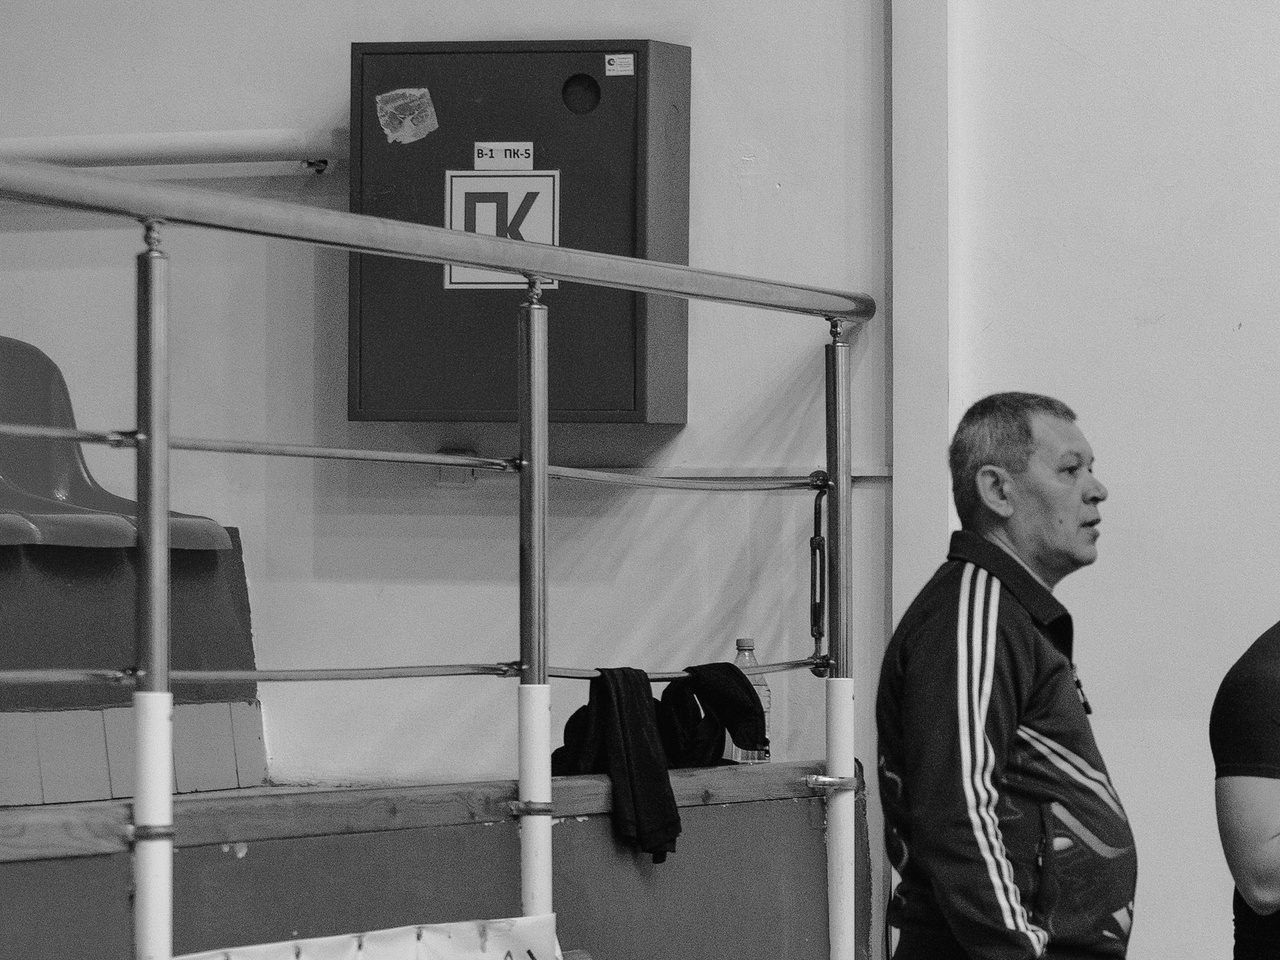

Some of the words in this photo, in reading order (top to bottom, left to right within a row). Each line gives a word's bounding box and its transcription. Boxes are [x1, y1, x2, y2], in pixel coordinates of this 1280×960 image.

[476, 148, 495, 159] В-1
[504, 148, 531, 159] ПК-5
[464, 191, 540, 242] ПК
